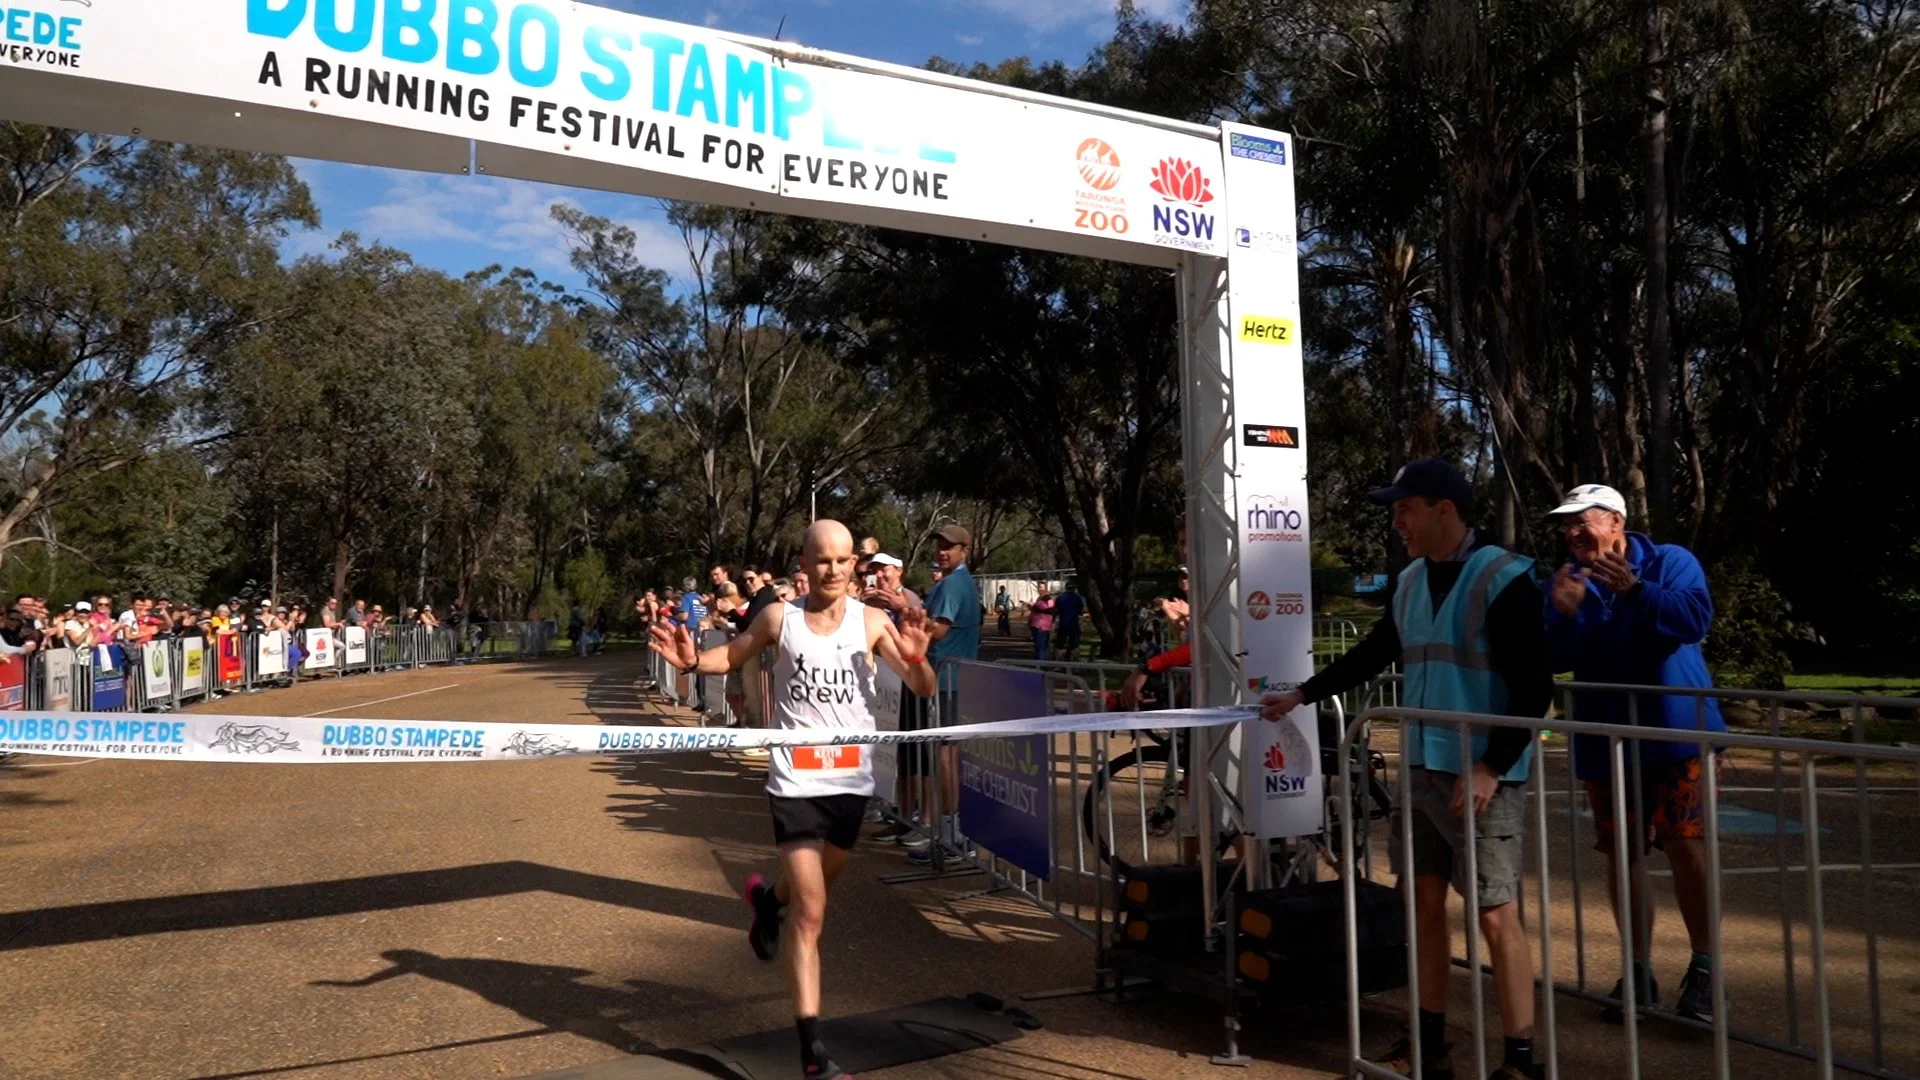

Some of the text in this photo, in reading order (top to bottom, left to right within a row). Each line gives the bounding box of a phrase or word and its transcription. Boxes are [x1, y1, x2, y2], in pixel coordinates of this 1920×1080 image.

[0, 8, 82, 50] EDE
[258, 51, 949, 200] A RUNNING FESTIVAL FOR EVERYONE
[1074, 208, 1129, 234] ZOO
[1153, 204, 1215, 240] NSW
[1154, 234, 1215, 251] GOVERNMENT
[1244, 320, 1286, 340] Hertz
[1247, 503, 1302, 530] rhino
[1248, 532, 1303, 544] promotions
[1275, 603, 1304, 615] ZOO
[811, 666, 854, 685] run
[790, 684, 854, 704] crew
[73, 719, 186, 743] STAMPEDE
[322, 725, 485, 749] DUBBO STAMPEDE
[598, 732, 738, 749] DUBBO STAMPEDE
[52, 743, 101, 753] FESTIVAL
[106, 744, 127, 753] FOR
[130, 744, 183, 755] EVERYONE
[373, 748, 414, 757] FESTIVAL
[417, 749, 435, 757] FOR
[438, 750, 483, 758] EVERYONE
[1266, 775, 1305, 793] NSW
